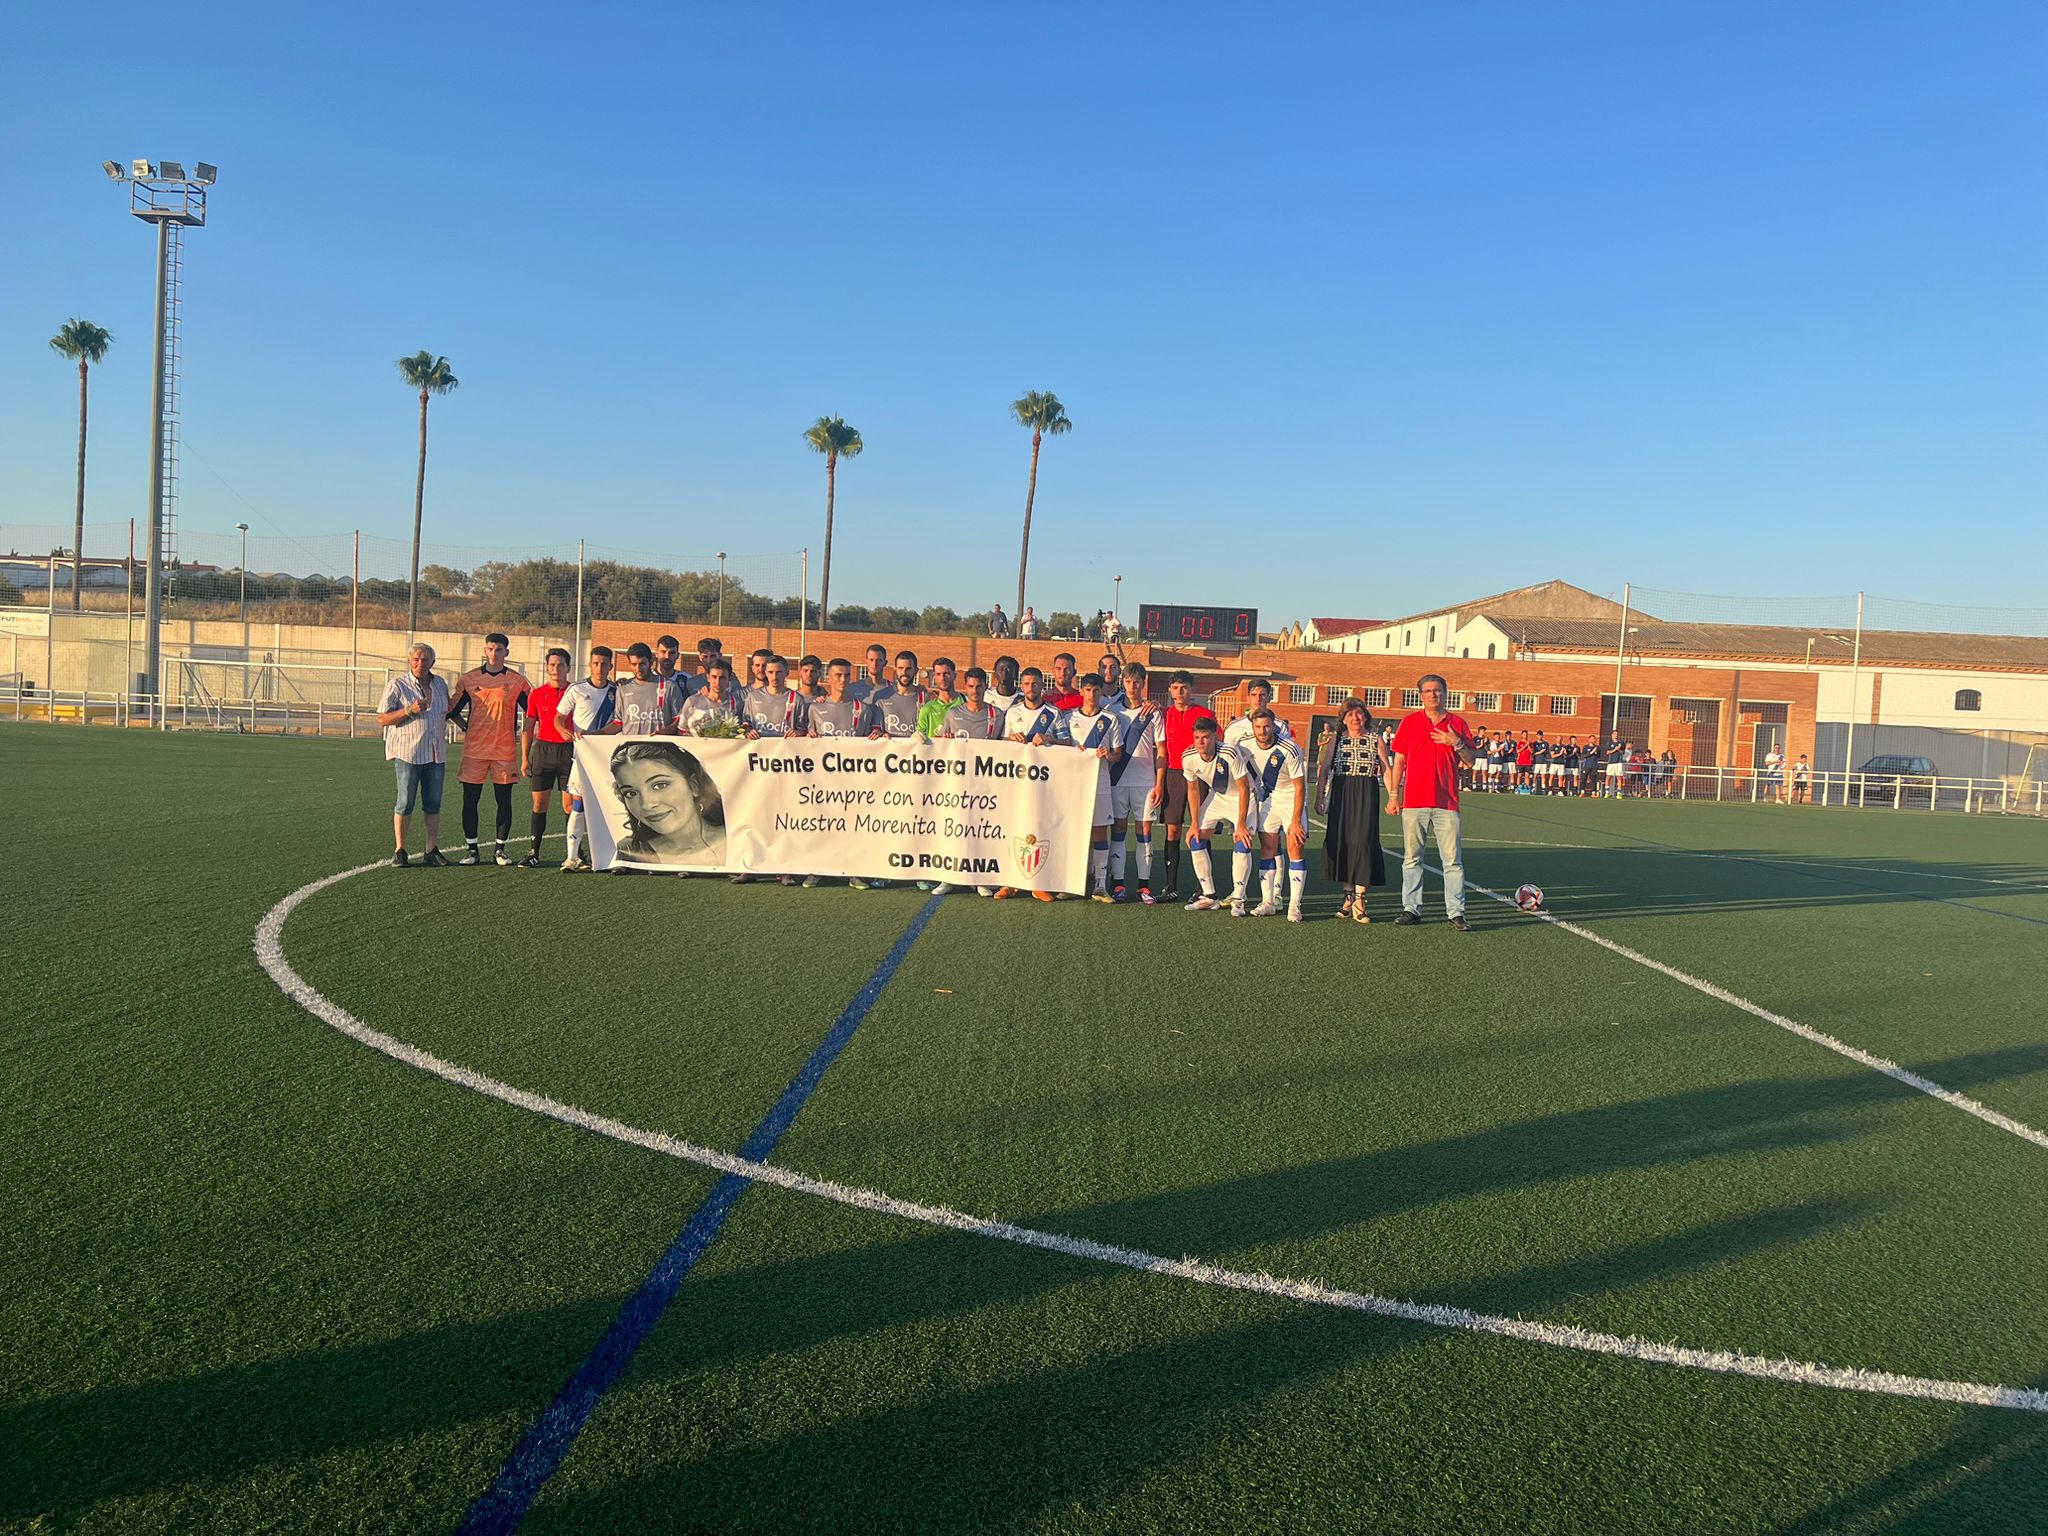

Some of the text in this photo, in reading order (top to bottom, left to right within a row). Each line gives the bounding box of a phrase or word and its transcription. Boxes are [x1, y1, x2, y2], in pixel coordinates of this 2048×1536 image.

[1235, 613, 1249, 635] 0
[748, 752, 1050, 781] Fuente Clara Cabrera Mateos
[799, 784, 998, 811] Siempre con nosotros
[775, 812, 1006, 839] Nuestra Morenita Bonita.
[888, 853, 1000, 872] CD ROCIANA
